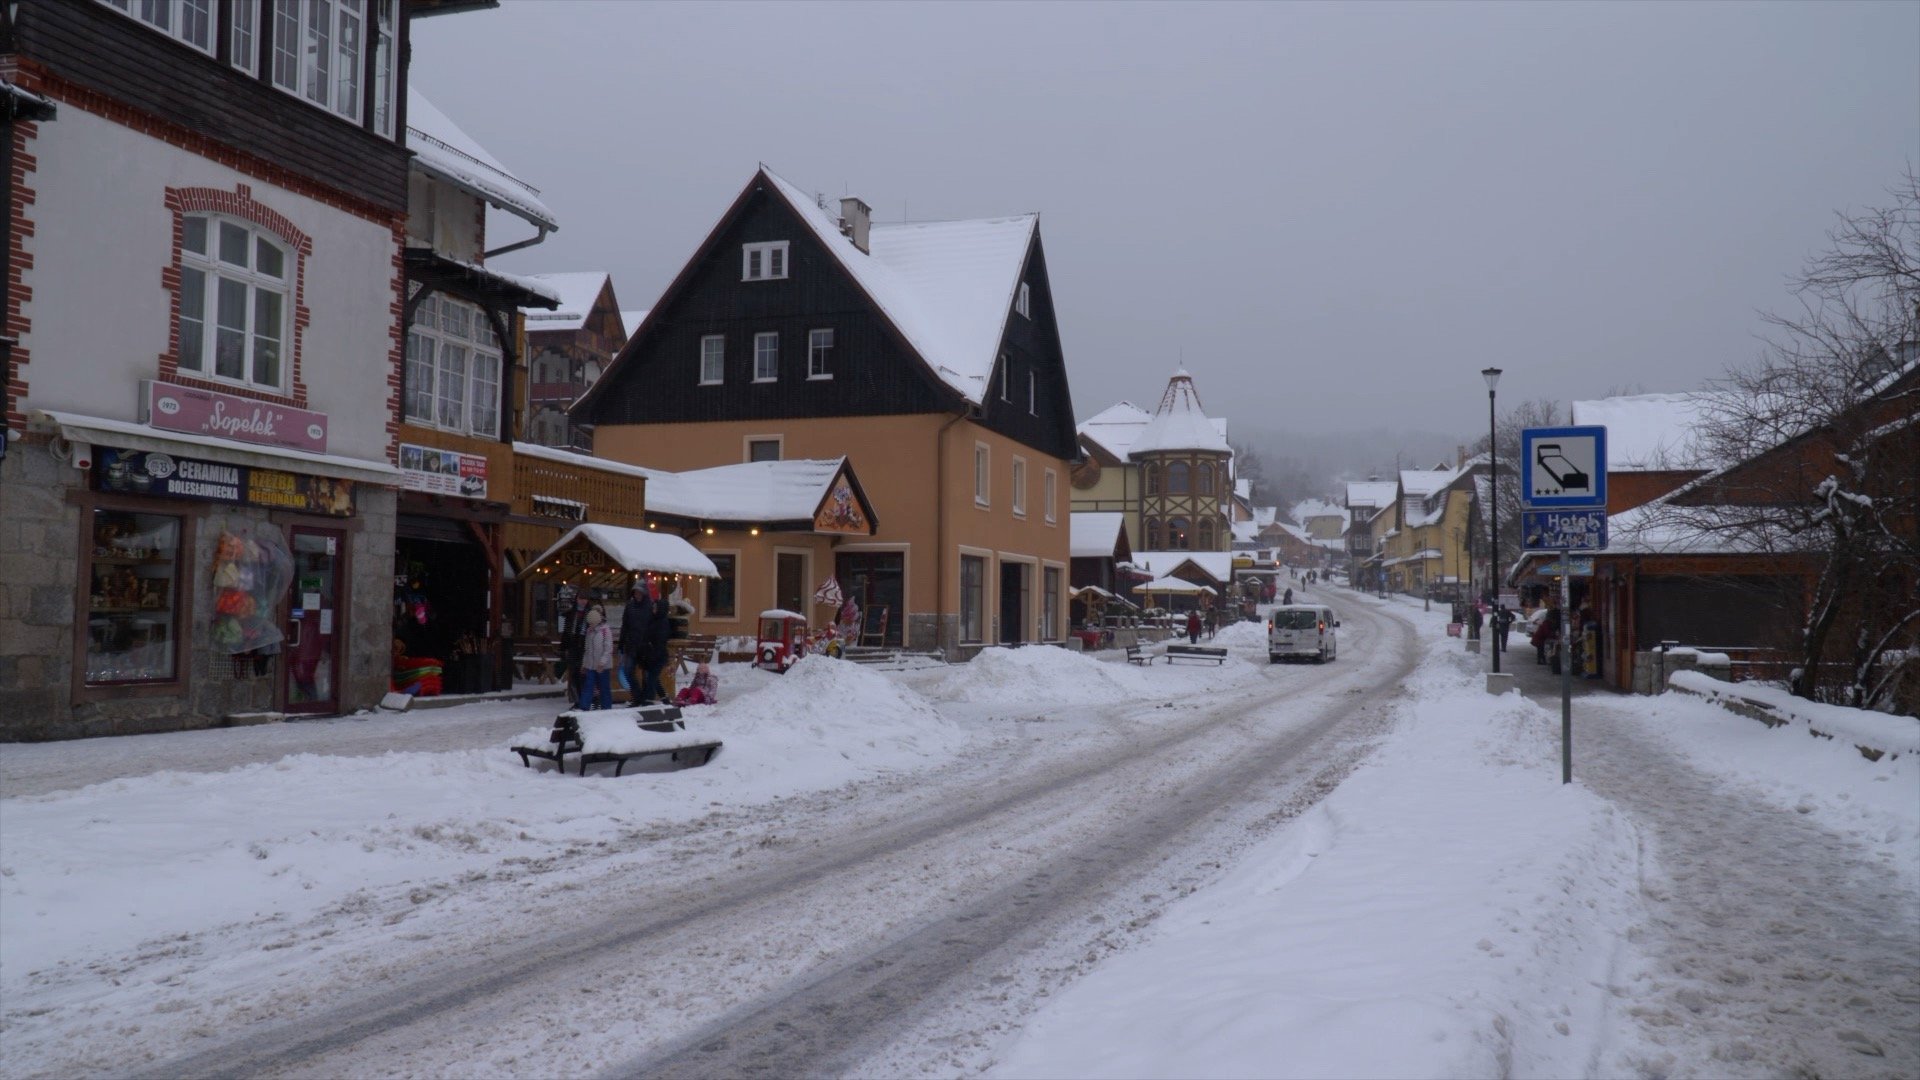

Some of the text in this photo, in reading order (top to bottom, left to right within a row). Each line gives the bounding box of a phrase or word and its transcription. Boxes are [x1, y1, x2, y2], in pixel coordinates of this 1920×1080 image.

[179, 461, 239, 485] CERAMIKA
[167, 480, 239, 500] BOLESŁAWIECKA
[249, 489, 306, 509] REGIONALNA
[1548, 513, 1591, 527] Hotel
